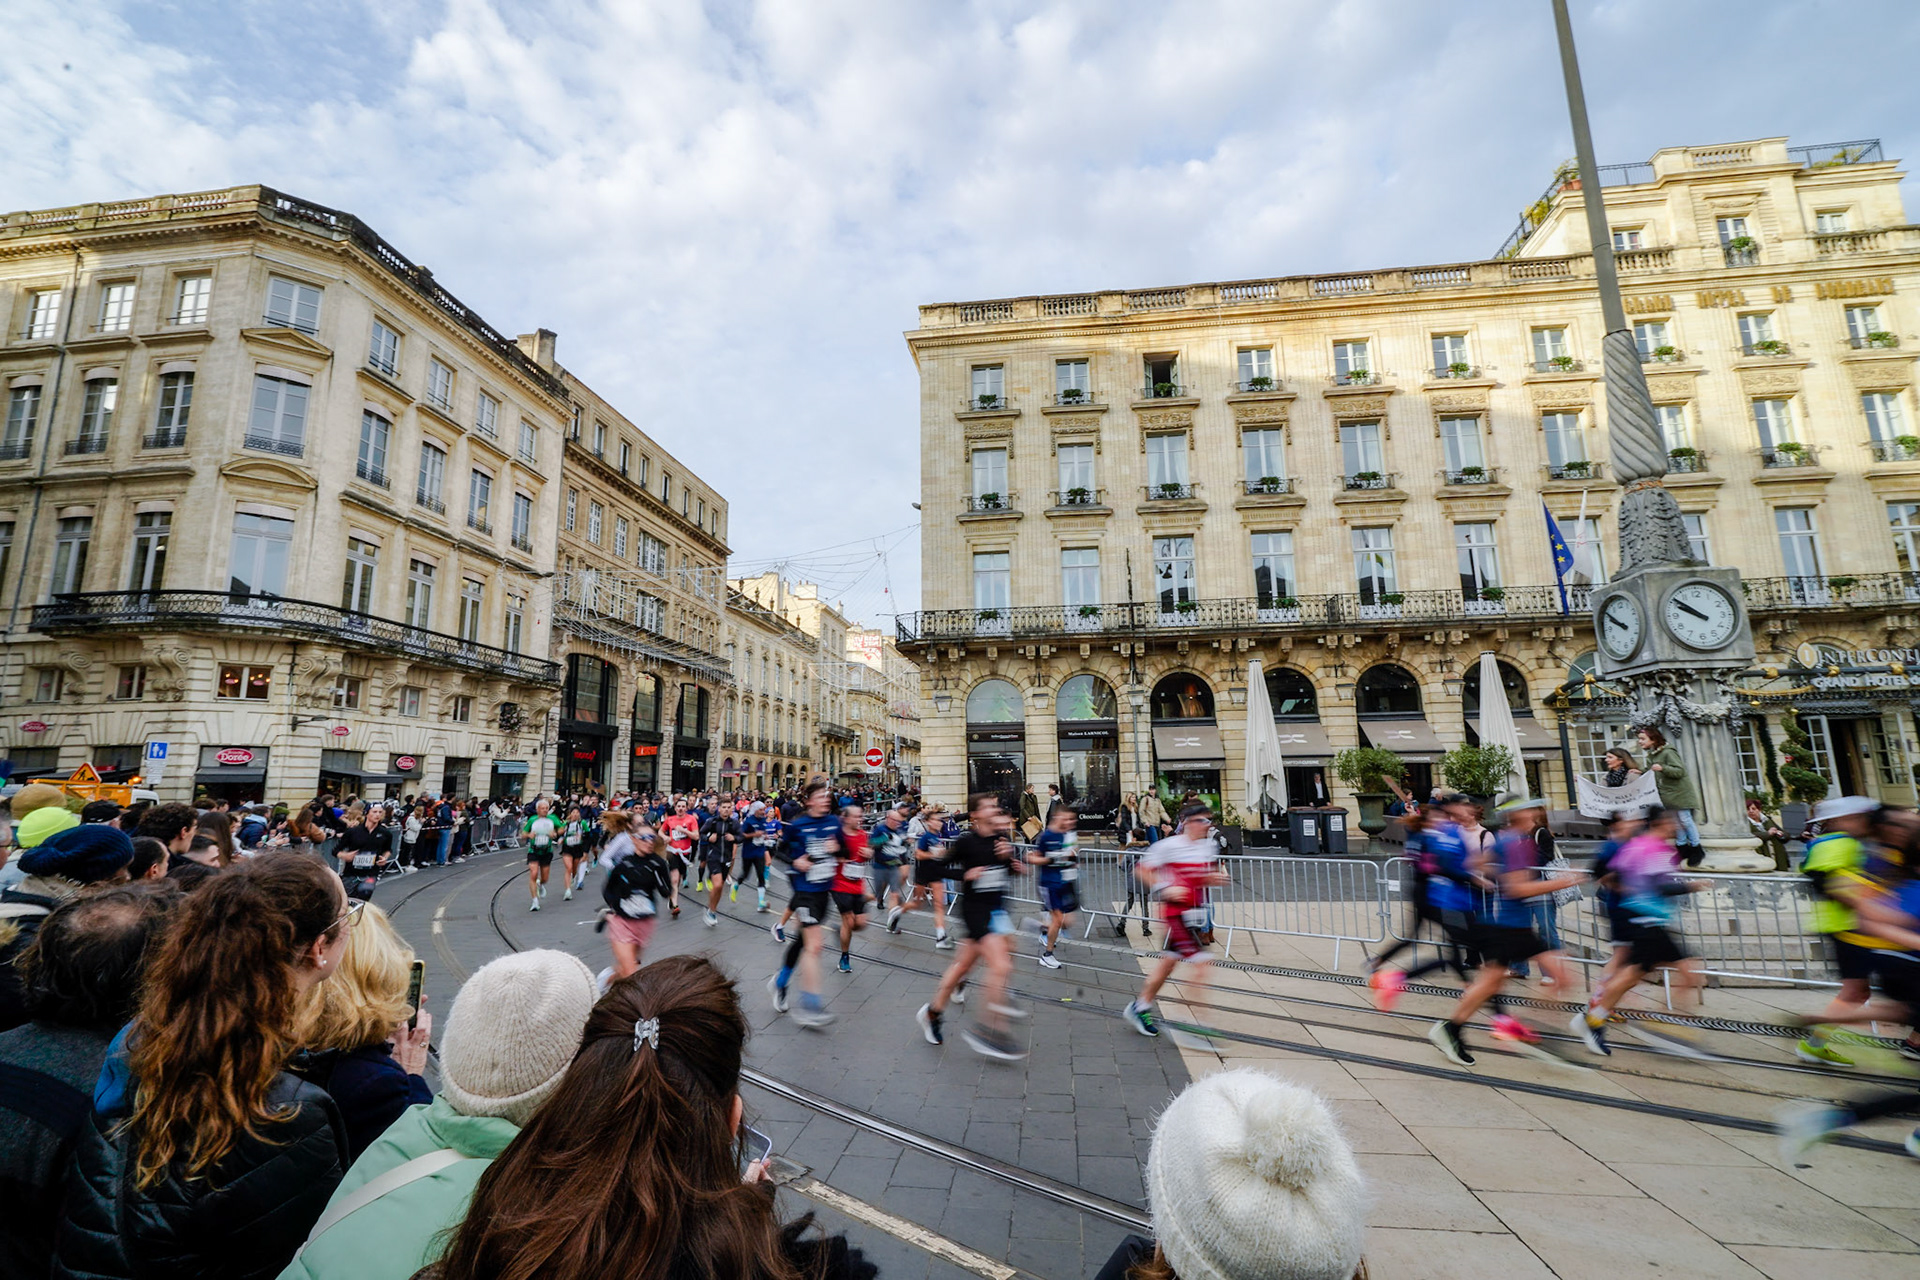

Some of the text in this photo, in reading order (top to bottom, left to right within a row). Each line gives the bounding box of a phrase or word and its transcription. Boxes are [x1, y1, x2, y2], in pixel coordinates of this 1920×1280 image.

[1715, 600, 1722, 608] 2
[1672, 612, 1679, 620] 9
[1811, 676, 1859, 688] GRAND
[1866, 675, 1909, 687] HOTEL
[221, 753, 249, 761] Dorée
